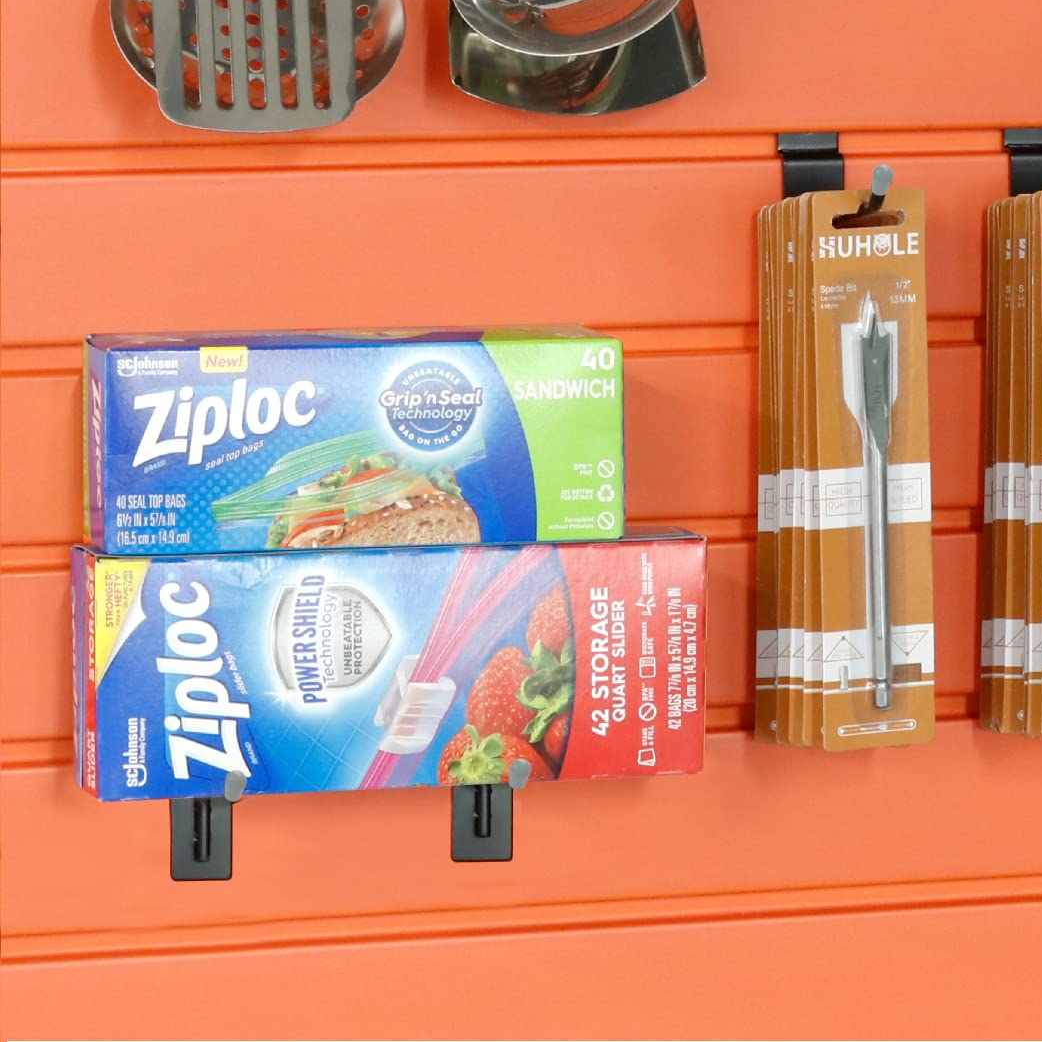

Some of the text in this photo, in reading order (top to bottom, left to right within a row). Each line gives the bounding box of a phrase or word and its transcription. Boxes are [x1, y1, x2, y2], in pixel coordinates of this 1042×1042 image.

[205, 354, 244, 369] New!
[580, 348, 615, 371] 40
[401, 367, 461, 386] UNBEATABLE
[513, 378, 615, 400] SANDWICH
[132, 378, 317, 467] Ziploc
[392, 406, 472, 421] Technology
[226, 449, 240, 462] top
[242, 439, 264, 455] bags
[128, 494, 147, 509] SEAL
[148, 494, 163, 508] TOP
[165, 493, 186, 508] BAGS
[319, 593, 338, 683] Technology
[343, 598, 353, 676] UNBEATABLE
[353, 600, 363, 675] PROTECTION
[683, 621, 697, 634] 4.7
[686, 642, 697, 655] cm
[590, 587, 610, 737] 42 STORAGE
[611, 600, 626, 723] QUART SLIDER
[683, 657, 697, 675] 14.9
[156, 581, 252, 779] Ziploc
[686, 684, 697, 697] cm
[667, 693, 682, 717] BAGS
[683, 698, 698, 712] (20
[668, 718, 682, 730] 42
